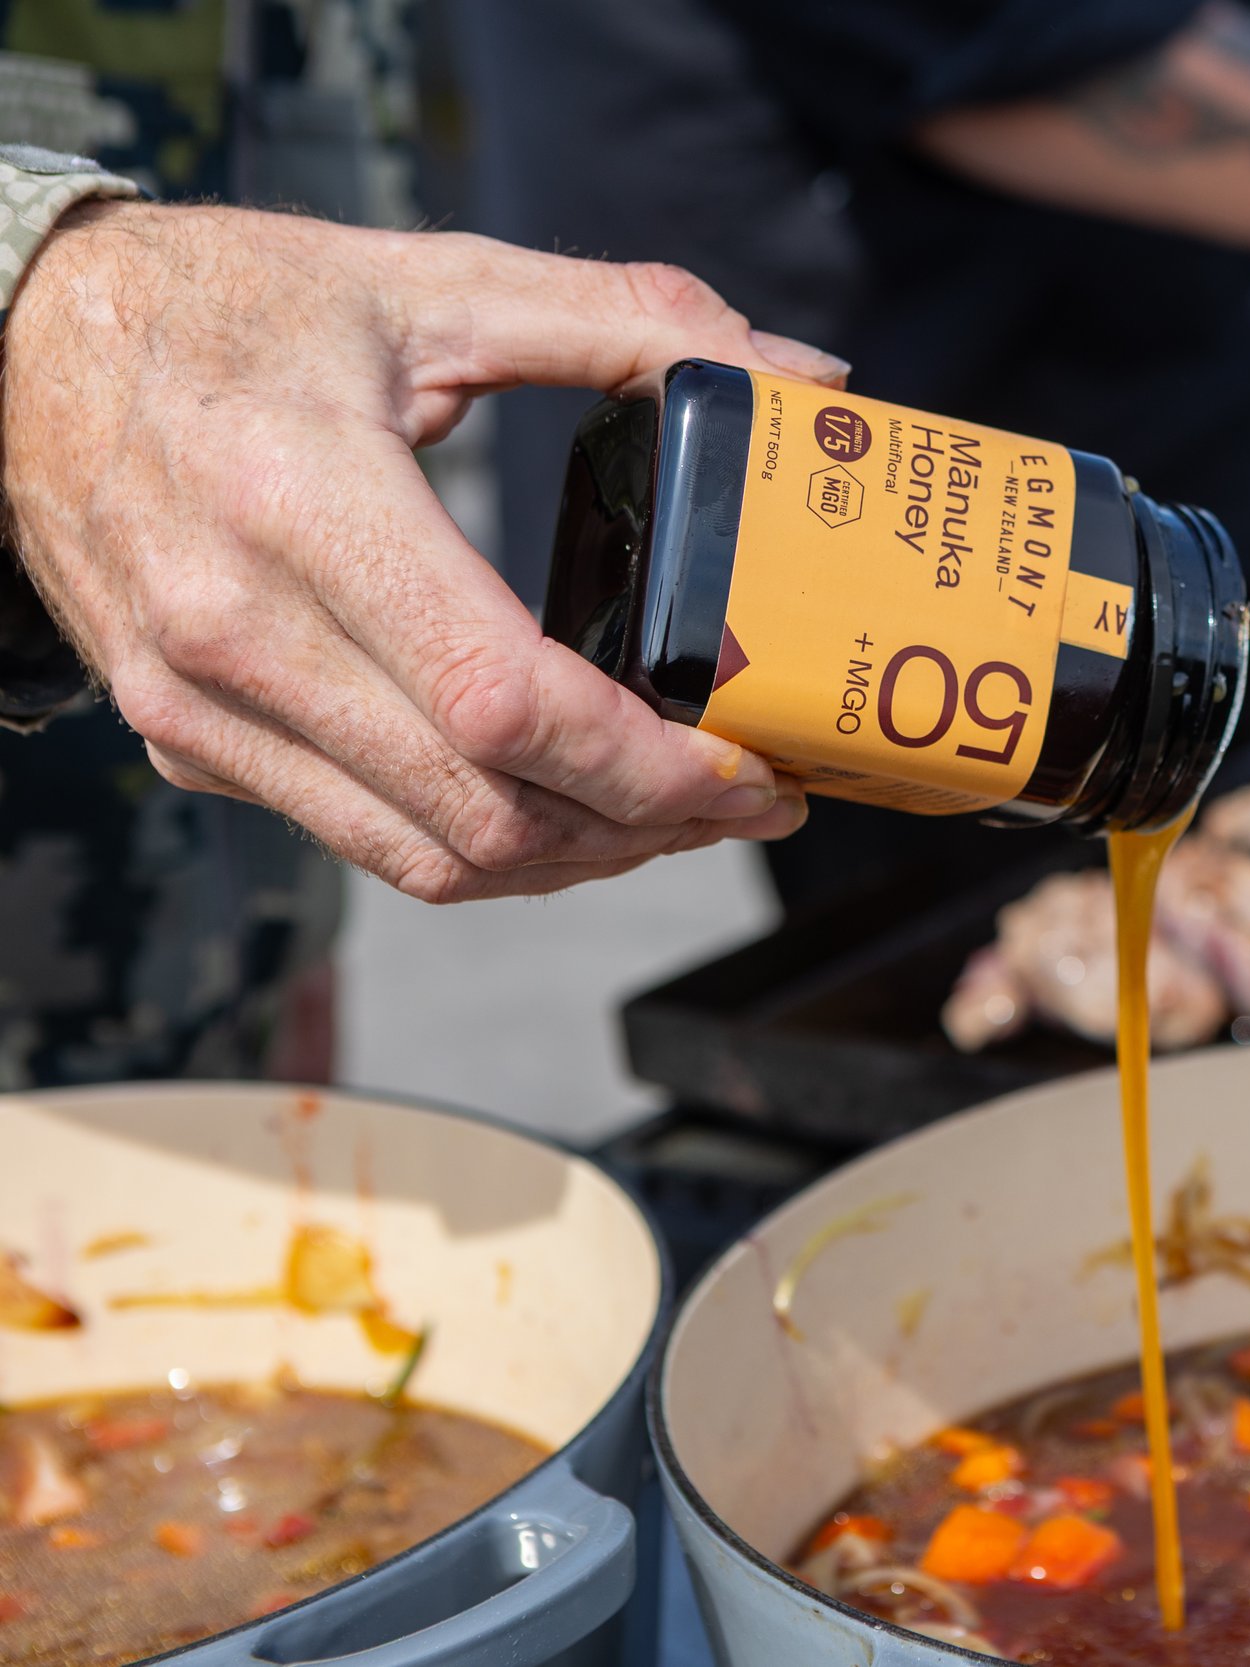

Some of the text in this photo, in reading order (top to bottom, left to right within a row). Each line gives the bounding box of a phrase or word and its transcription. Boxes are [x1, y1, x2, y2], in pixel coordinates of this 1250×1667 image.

[769, 416, 782, 440] WT
[770, 389, 783, 415] NET
[765, 441, 779, 470] 500
[823, 413, 852, 453] 1/5
[853, 419, 863, 454] STRENGTH
[884, 418, 903, 495] Multifloral
[820, 476, 842, 514] MGO
[839, 481, 851, 517] CERTIFIED
[894, 424, 945, 555] Honey
[935, 433, 983, 589] Mānuka
[996, 475, 1019, 575] NEW ZEALAND
[1008, 455, 1055, 617] EGMONT
[836, 659, 873, 736] MGO
[877, 644, 1033, 766] 50
